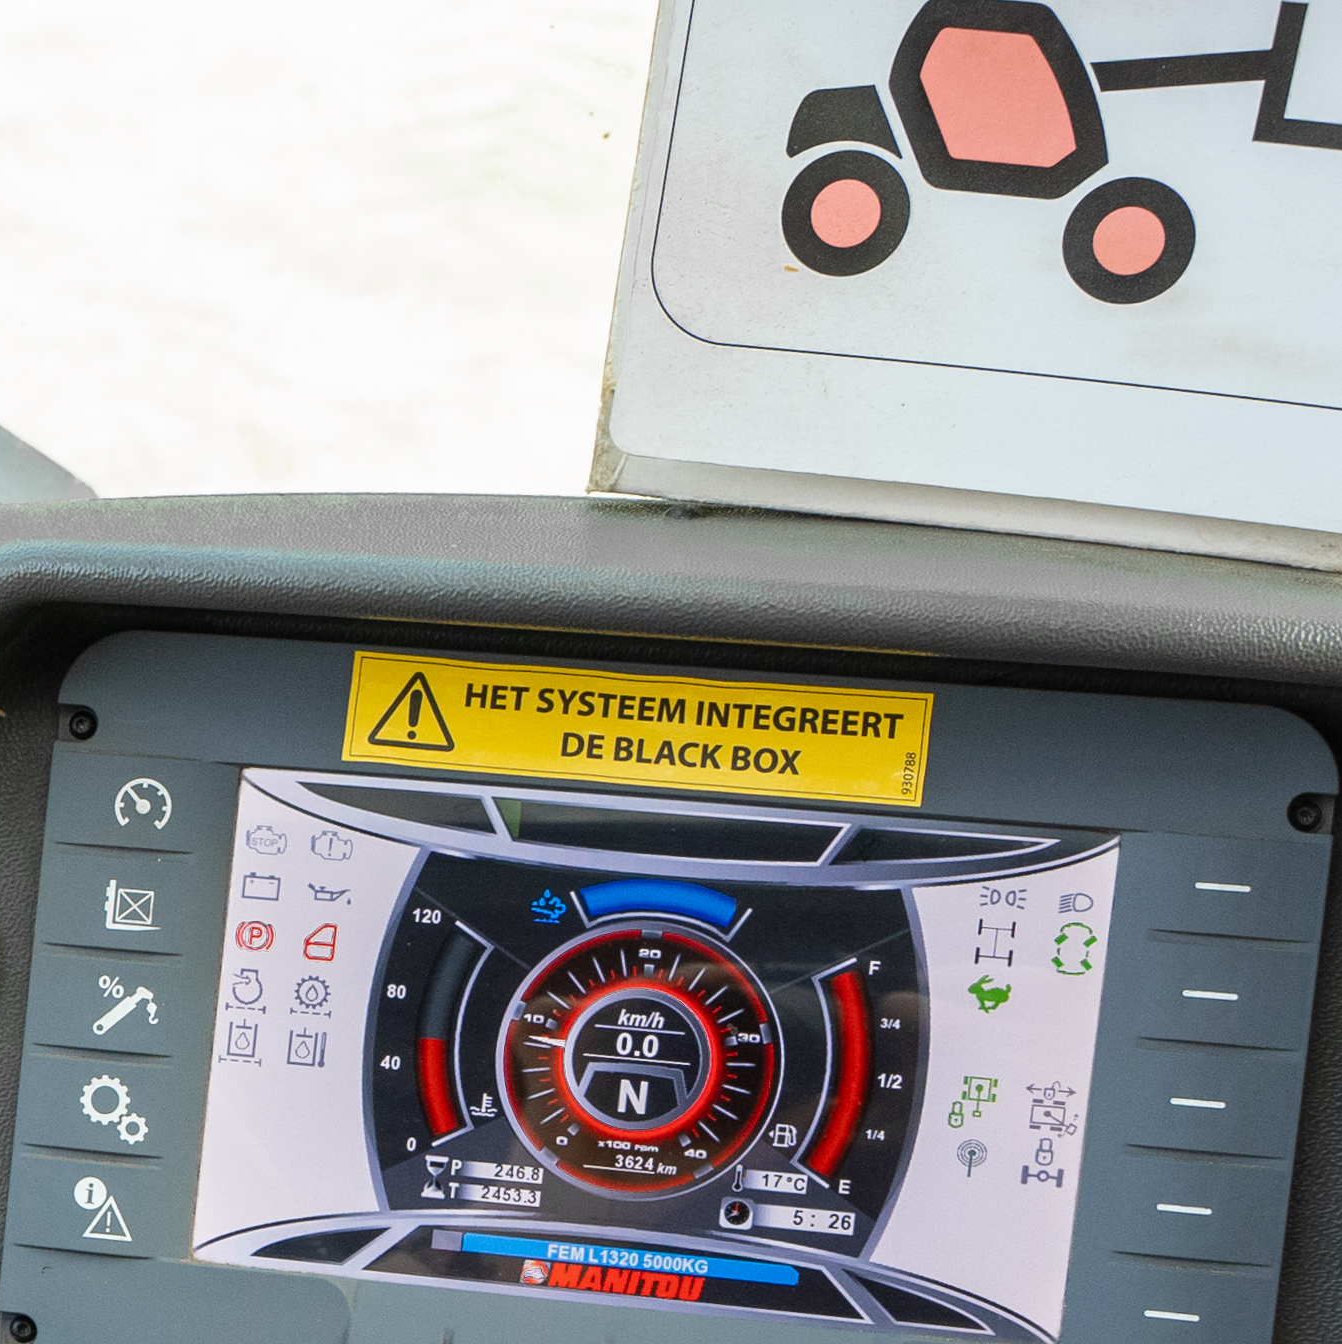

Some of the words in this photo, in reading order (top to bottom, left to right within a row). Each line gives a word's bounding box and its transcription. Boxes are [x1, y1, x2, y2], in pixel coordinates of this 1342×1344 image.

[464, 683, 530, 711] HET
[536, 687, 686, 724] SYSTEEM
[696, 700, 904, 739] INTEGREERT
[560, 732, 605, 759] DE
[613, 735, 723, 770] BLACK
[731, 745, 802, 776] BOX
[901, 752, 917, 795] 930788
[250, 836, 279, 848] STOP
[412, 908, 442, 925] 120
[638, 948, 662, 959] 20
[868, 960, 882, 976] F
[386, 984, 407, 999] 80
[523, 1013, 545, 1024] 10
[617, 1008, 665, 1029] km/h
[879, 1017, 901, 1031] 3/4
[616, 1032, 660, 1058] 0.0
[738, 1033, 761, 1044] 30
[379, 1055, 401, 1070] 40
[877, 1073, 903, 1089] 1/2
[617, 1079, 649, 1115] N
[865, 1128, 886, 1141] 1/4
[406, 1137, 417, 1152] 0
[597, 1140, 632, 1151] x100
[633, 1143, 660, 1154] rpm
[684, 1149, 708, 1160] 40
[450, 1159, 463, 1176] P
[493, 1163, 541, 1181] 246.8
[614, 1154, 655, 1171] 3624
[656, 1162, 678, 1175] km
[449, 1182, 461, 1199] T
[480, 1185, 538, 1204] 2453.3
[838, 1179, 852, 1195] E
[547, 1243, 585, 1262] FEM
[588, 1247, 639, 1267] L1320
[642, 1252, 709, 1274] 5000KG
[547, 1261, 706, 1302] MANITOU
